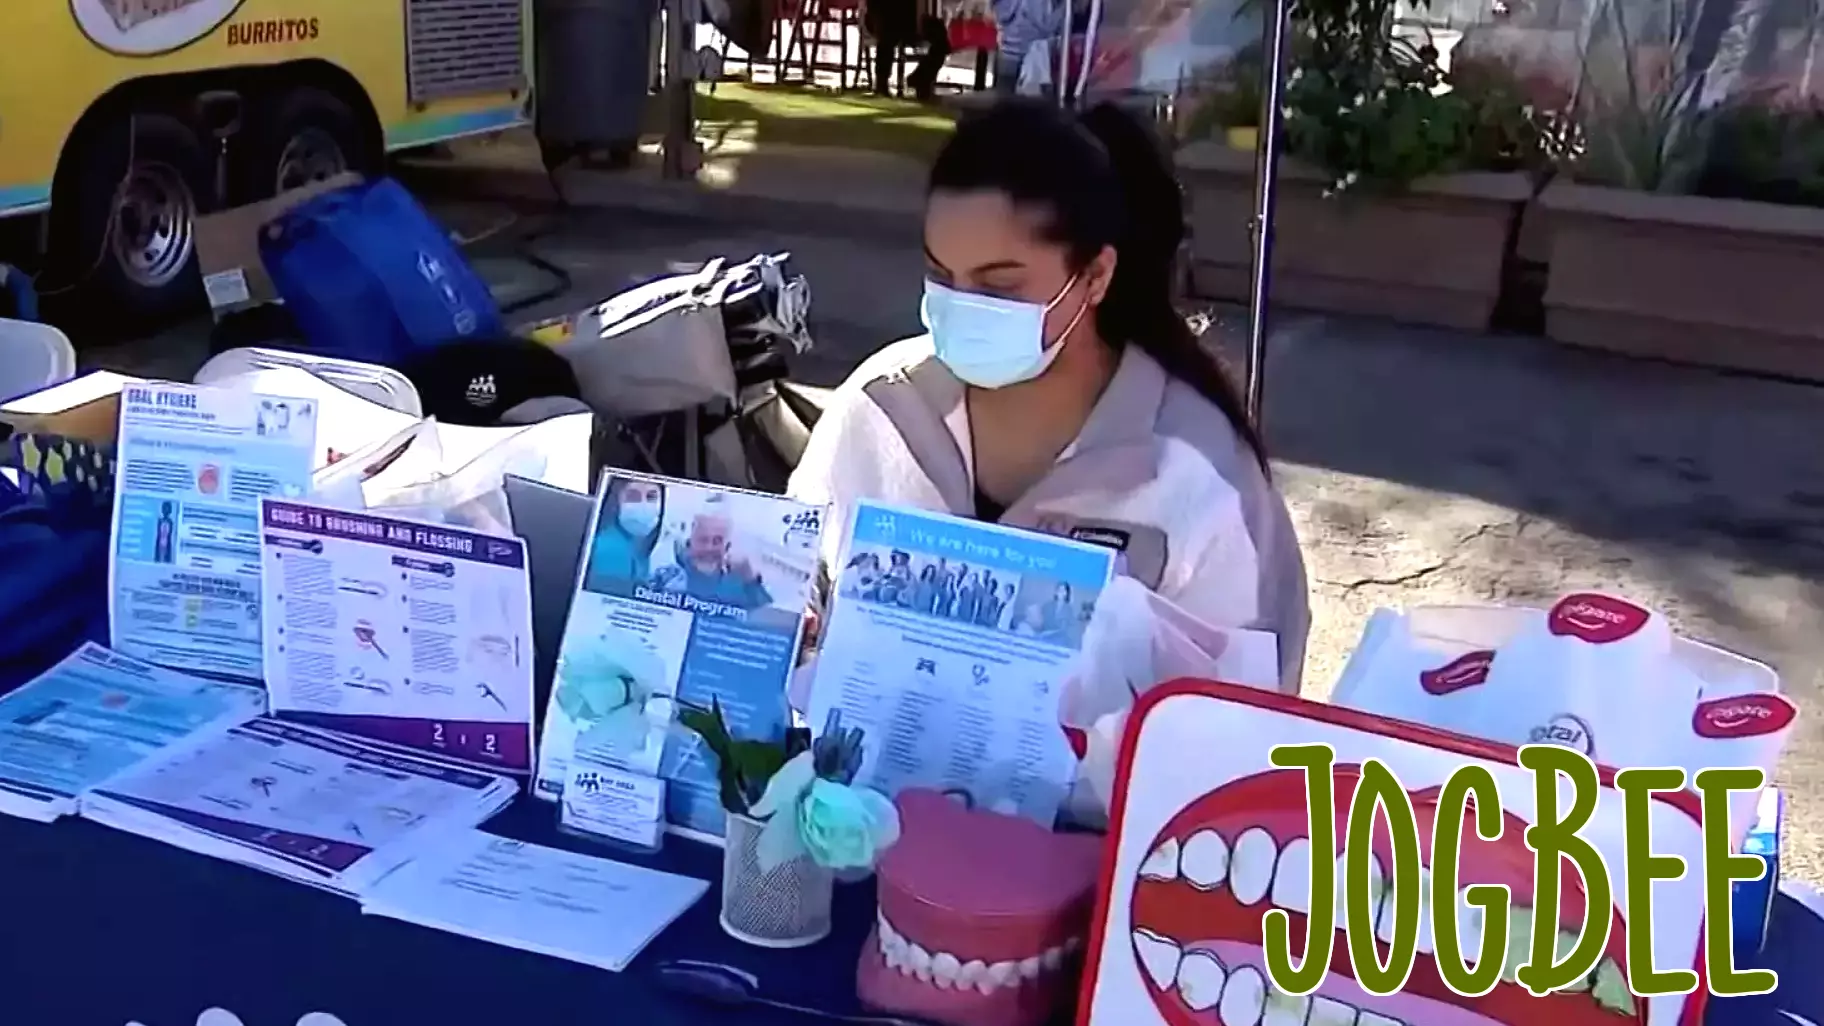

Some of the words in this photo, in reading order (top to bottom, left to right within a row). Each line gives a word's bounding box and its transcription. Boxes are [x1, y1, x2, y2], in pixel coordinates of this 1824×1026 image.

[227, 17, 319, 45] BURRITOS
[308, 513, 323, 529] TO
[325, 516, 384, 538] BRUSHING
[388, 525, 412, 542] AND
[415, 530, 473, 554] FLOSSING
[911, 529, 934, 544] We
[938, 534, 963, 551] are
[635, 585, 682, 608] Dental
[684, 594, 748, 623] Program
[433, 723, 444, 740] 2
[485, 734, 496, 752] 2
